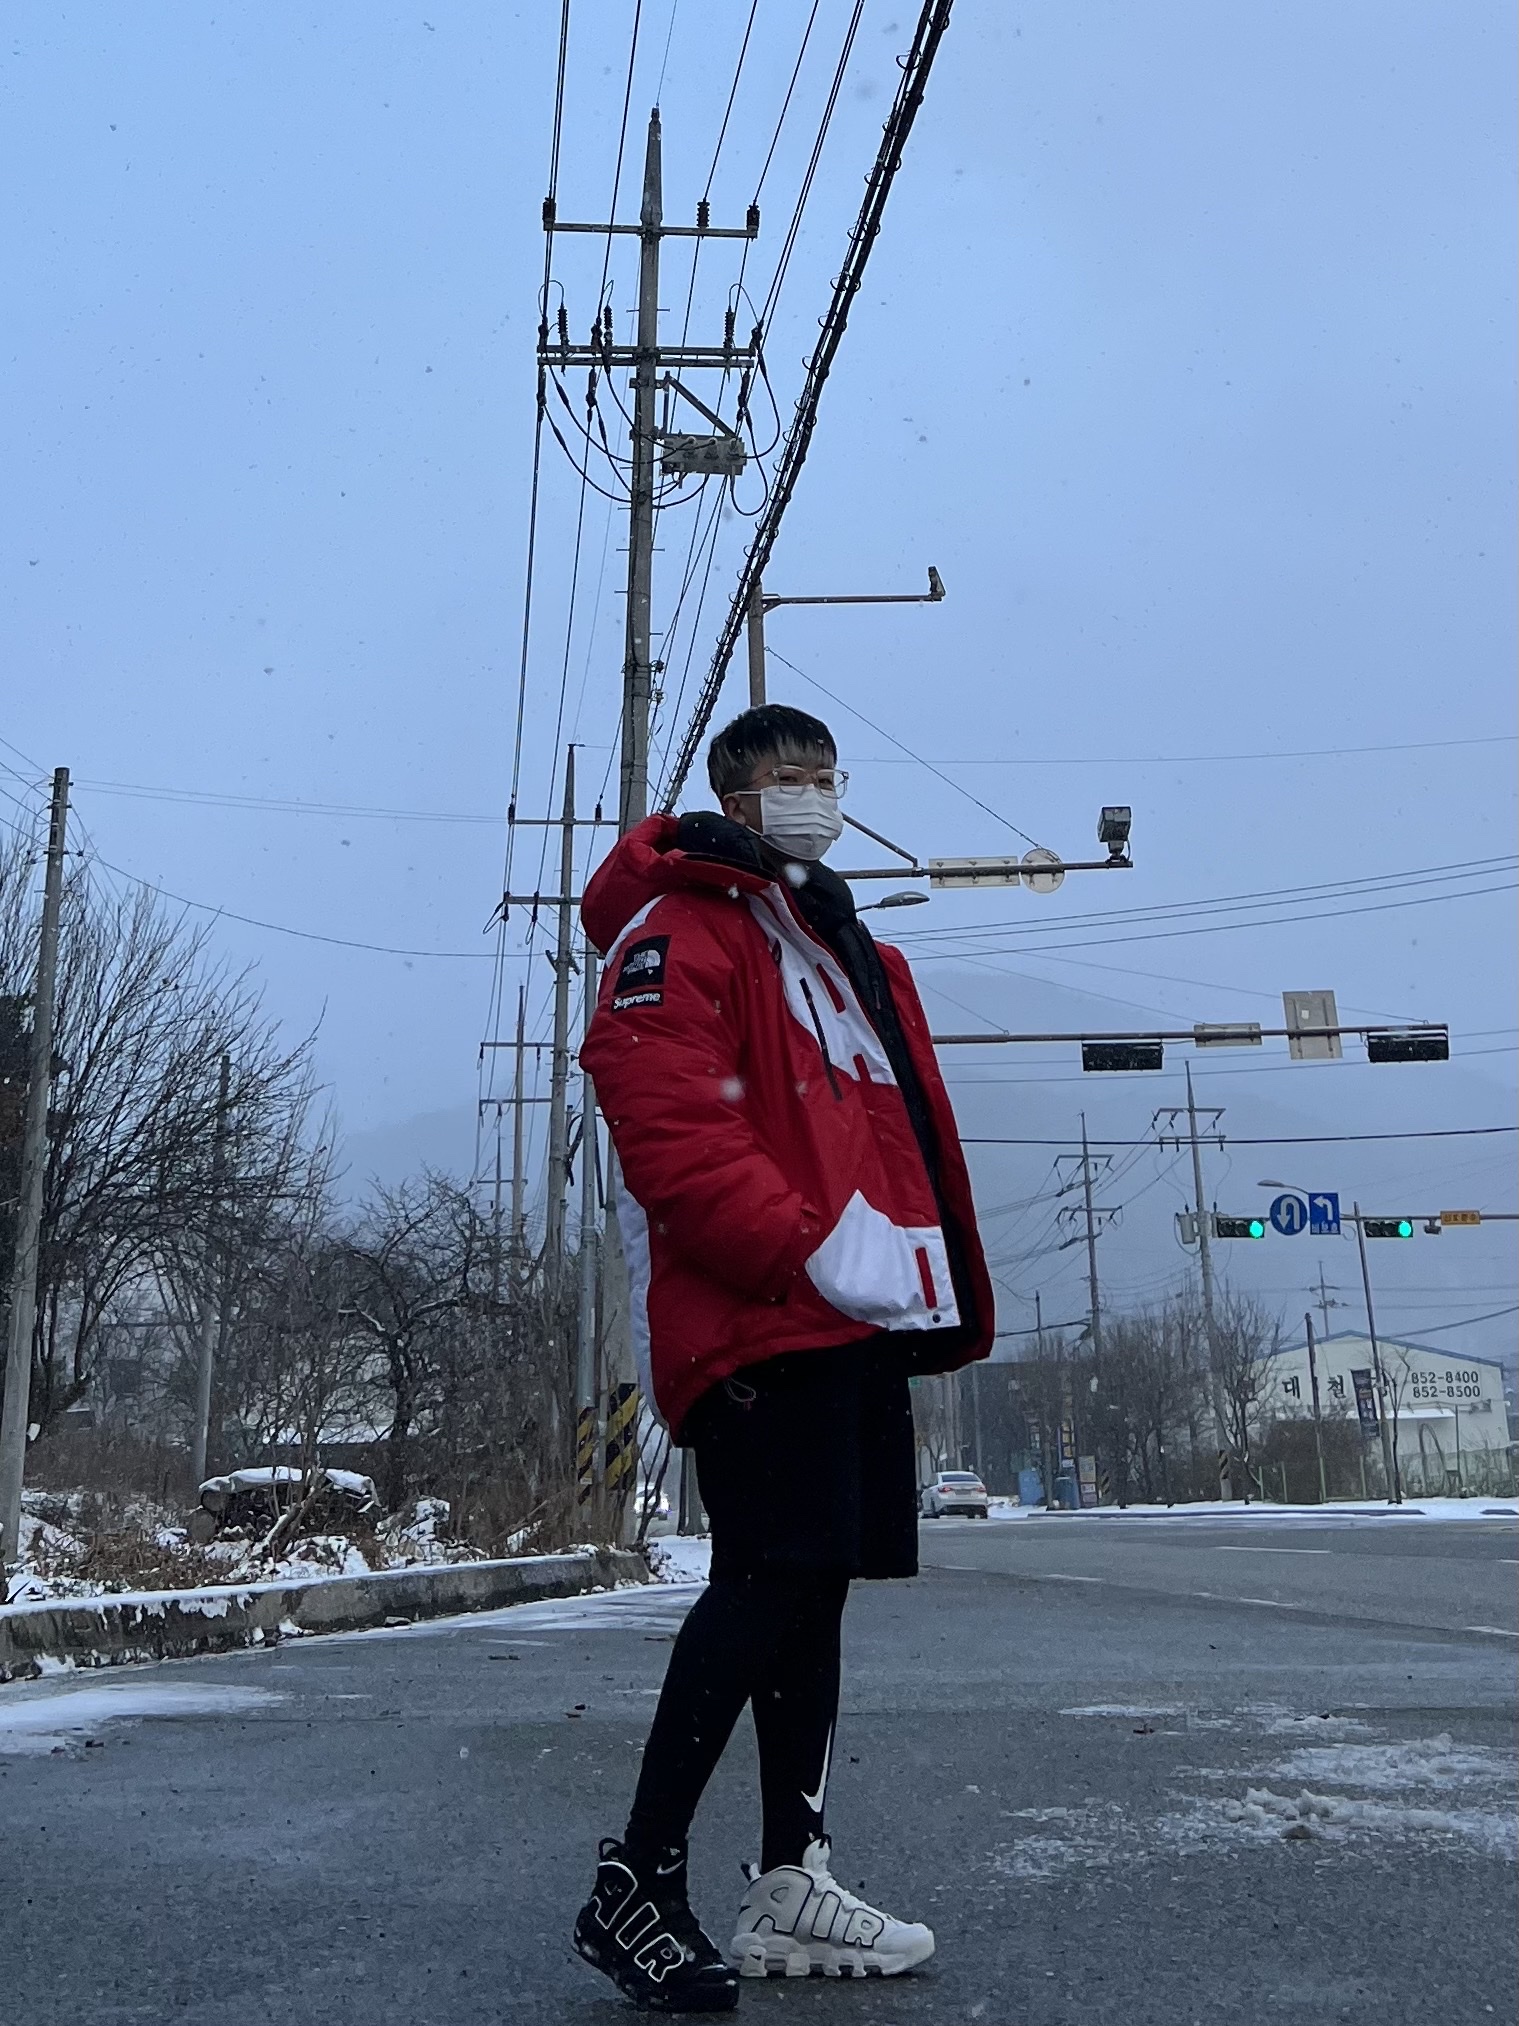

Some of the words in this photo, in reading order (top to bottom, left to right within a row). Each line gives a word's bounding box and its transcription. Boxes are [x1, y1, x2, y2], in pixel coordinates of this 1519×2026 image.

[613, 992, 661, 1010] Supreme
[1411, 1371, 1479, 1384] 852-8400
[1412, 1385, 1481, 1398] 852-8500
[747, 1865, 885, 1948] AIR
[588, 1860, 685, 1983] AIR
